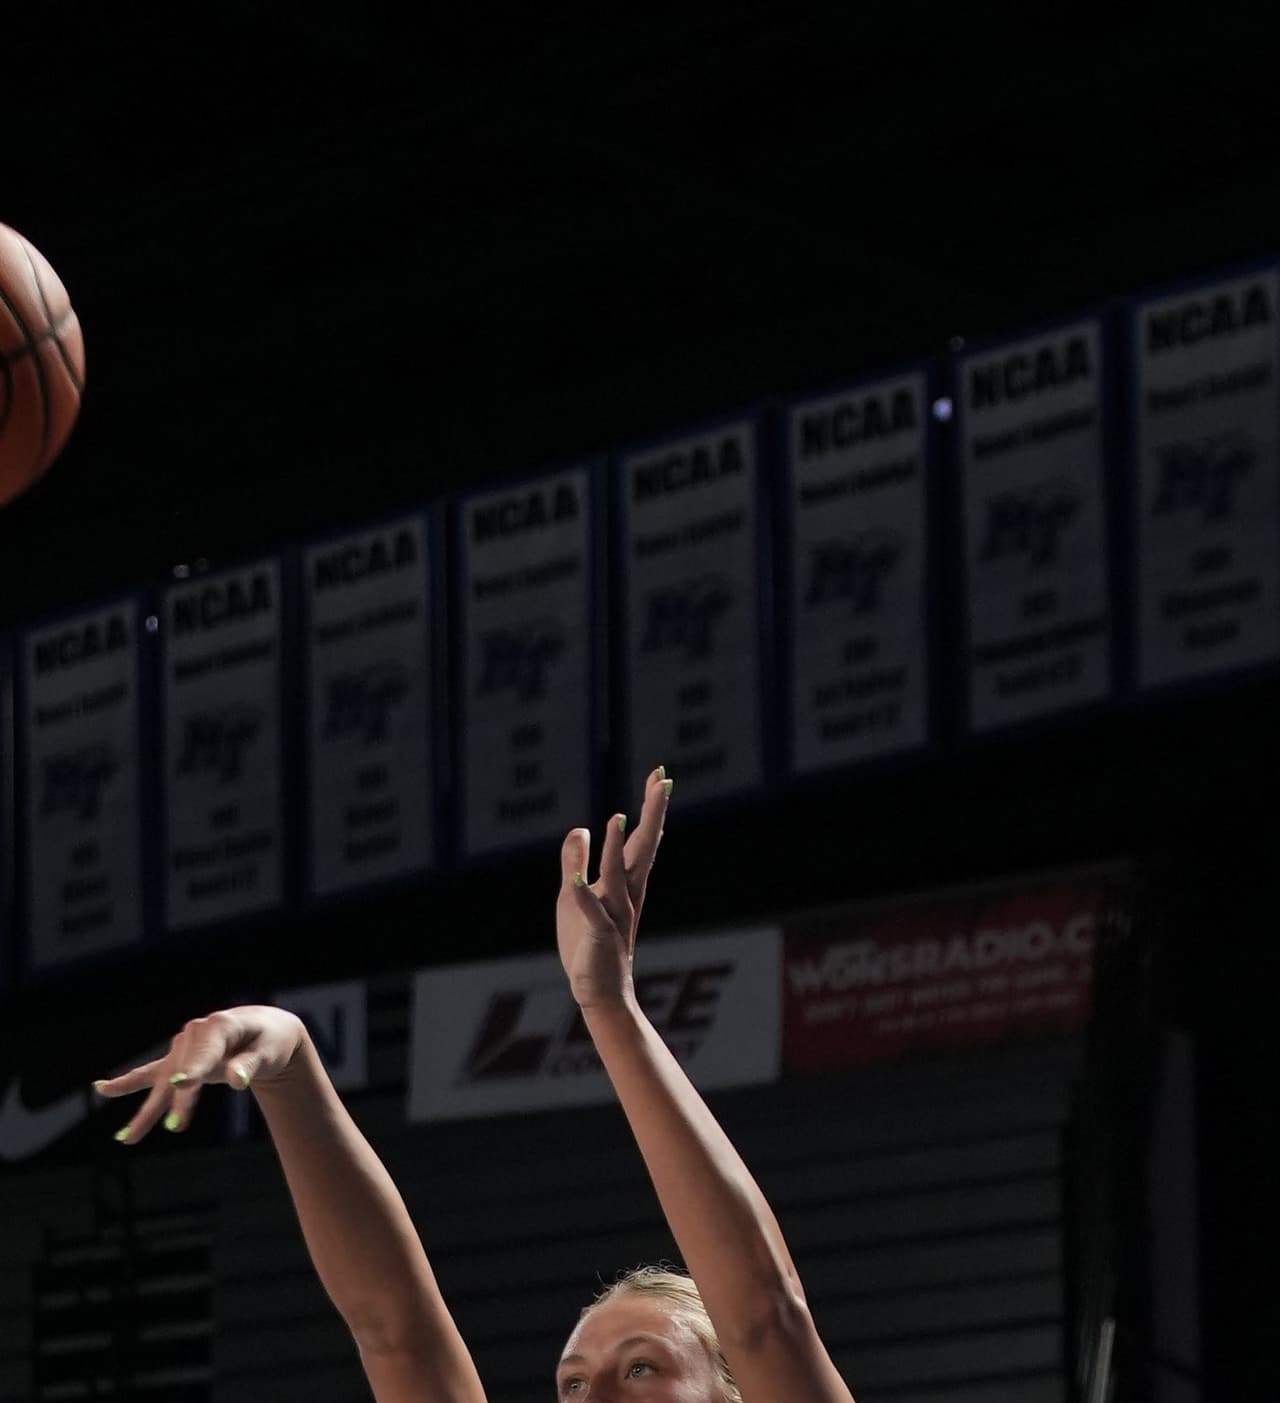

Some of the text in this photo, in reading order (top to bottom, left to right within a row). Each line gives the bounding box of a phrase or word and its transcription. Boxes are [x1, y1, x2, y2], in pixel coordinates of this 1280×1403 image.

[1148, 285, 1271, 353] NCAA
[969, 335, 1092, 410] NCAA
[799, 388, 917, 459] NCAA
[632, 436, 745, 503] NCAA
[471, 483, 580, 544] NCAA
[313, 530, 418, 590] NCAA
[172, 574, 273, 634] NCAA
[33, 614, 131, 674] NCAA
